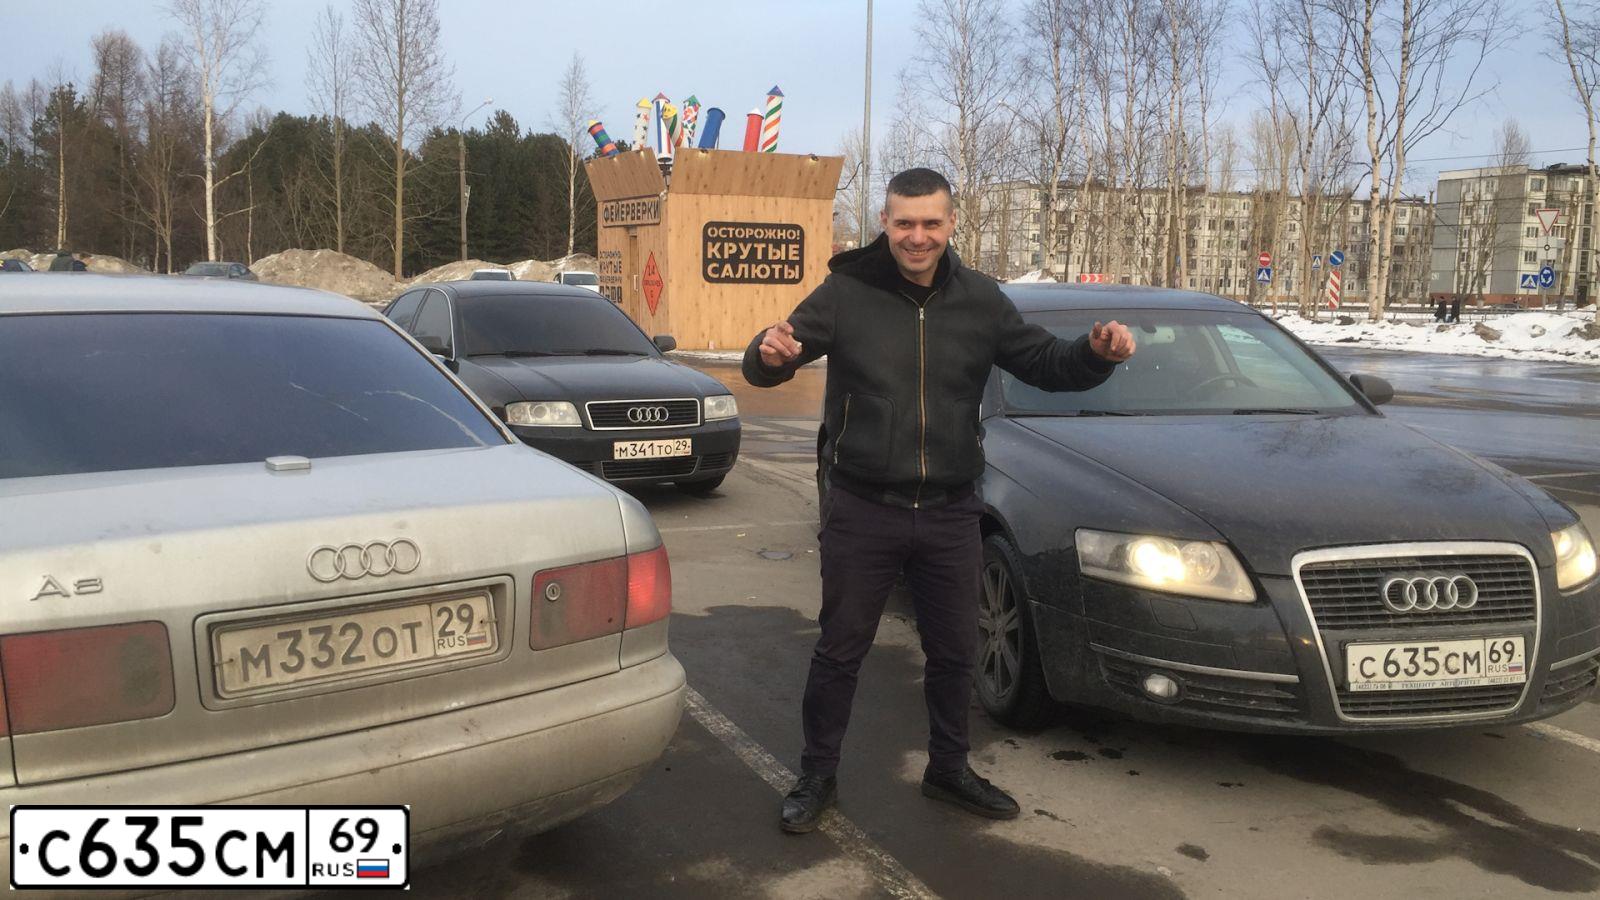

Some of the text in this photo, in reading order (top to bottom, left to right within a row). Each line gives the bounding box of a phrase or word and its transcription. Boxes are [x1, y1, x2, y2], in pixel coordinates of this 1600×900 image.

[603, 200, 659, 224] ФЕЙЕРВЕРКИ
[707, 226, 800, 240] ОСТОРОЖНО!
[707, 241, 800, 260] КРУТЫЕ
[707, 263, 800, 280] САЛЮТЫ
[676, 440, 687, 450] 29
[29, 574, 104, 601] A8
[239, 603, 474, 682] М332ОТ 29
[437, 636, 466, 650] RUS
[1359, 640, 1515, 679] С635СМ 69
[1488, 664, 1508, 673] RUS
